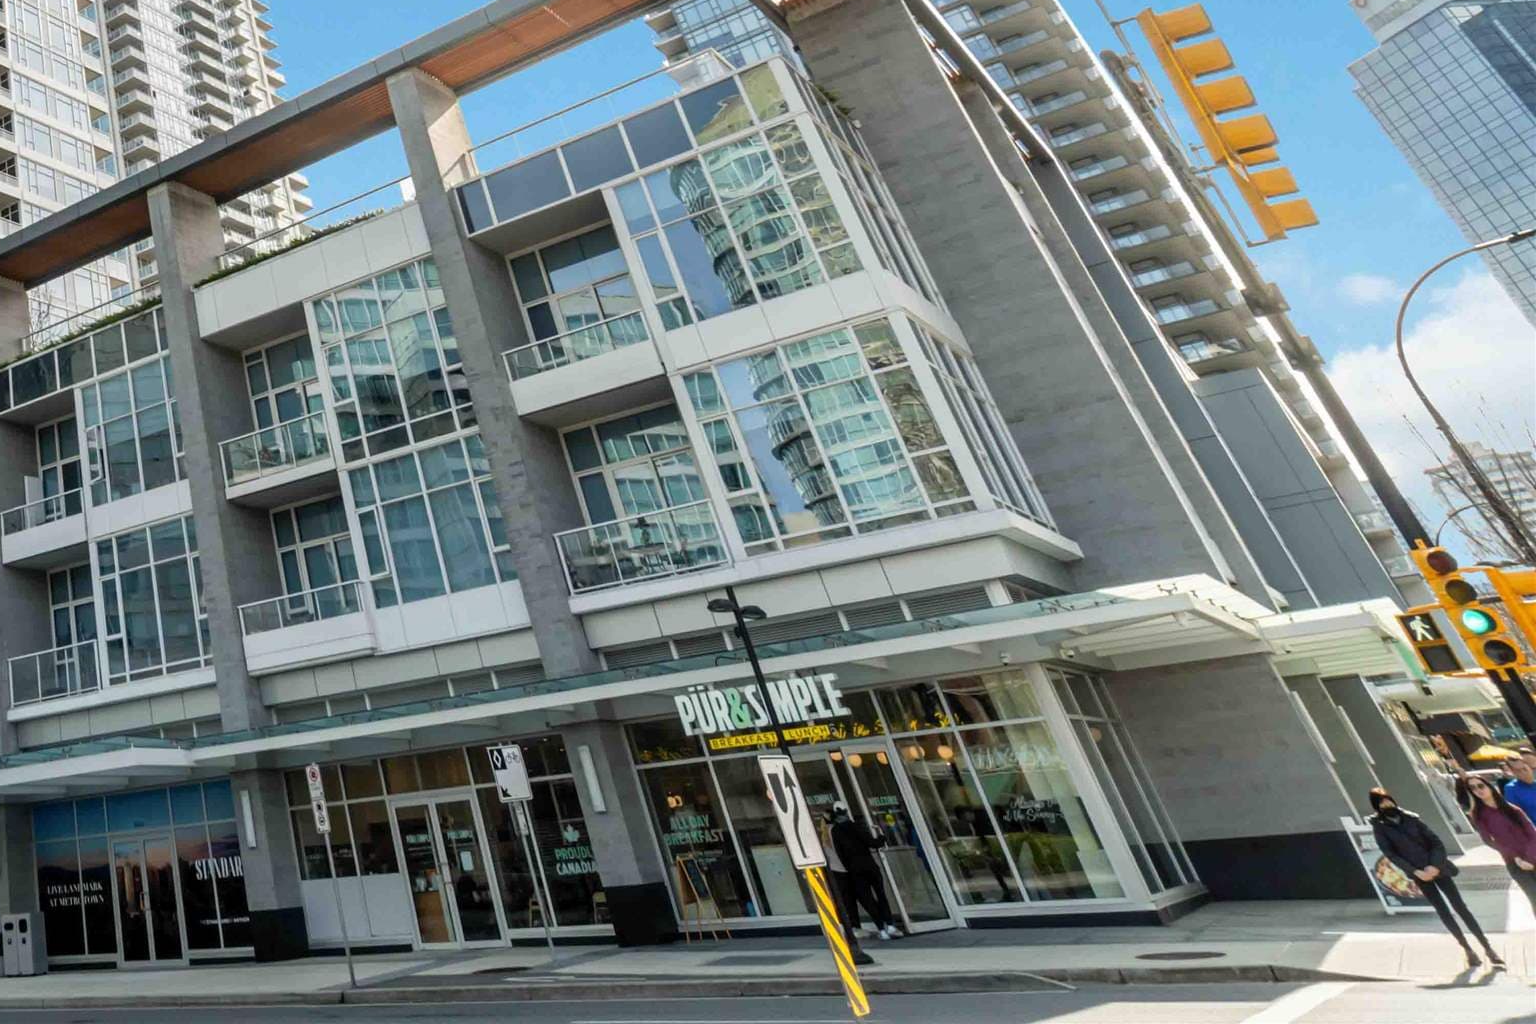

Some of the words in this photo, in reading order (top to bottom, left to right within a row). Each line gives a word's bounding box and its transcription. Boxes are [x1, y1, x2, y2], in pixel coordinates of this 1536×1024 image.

[674, 673, 852, 736] PÜR&SMPLE
[790, 726, 828, 739] LUNCH
[555, 846, 592, 860] PROUDL
[195, 856, 243, 880] STNDAR
[59, 894, 104, 906] METRTOWN
